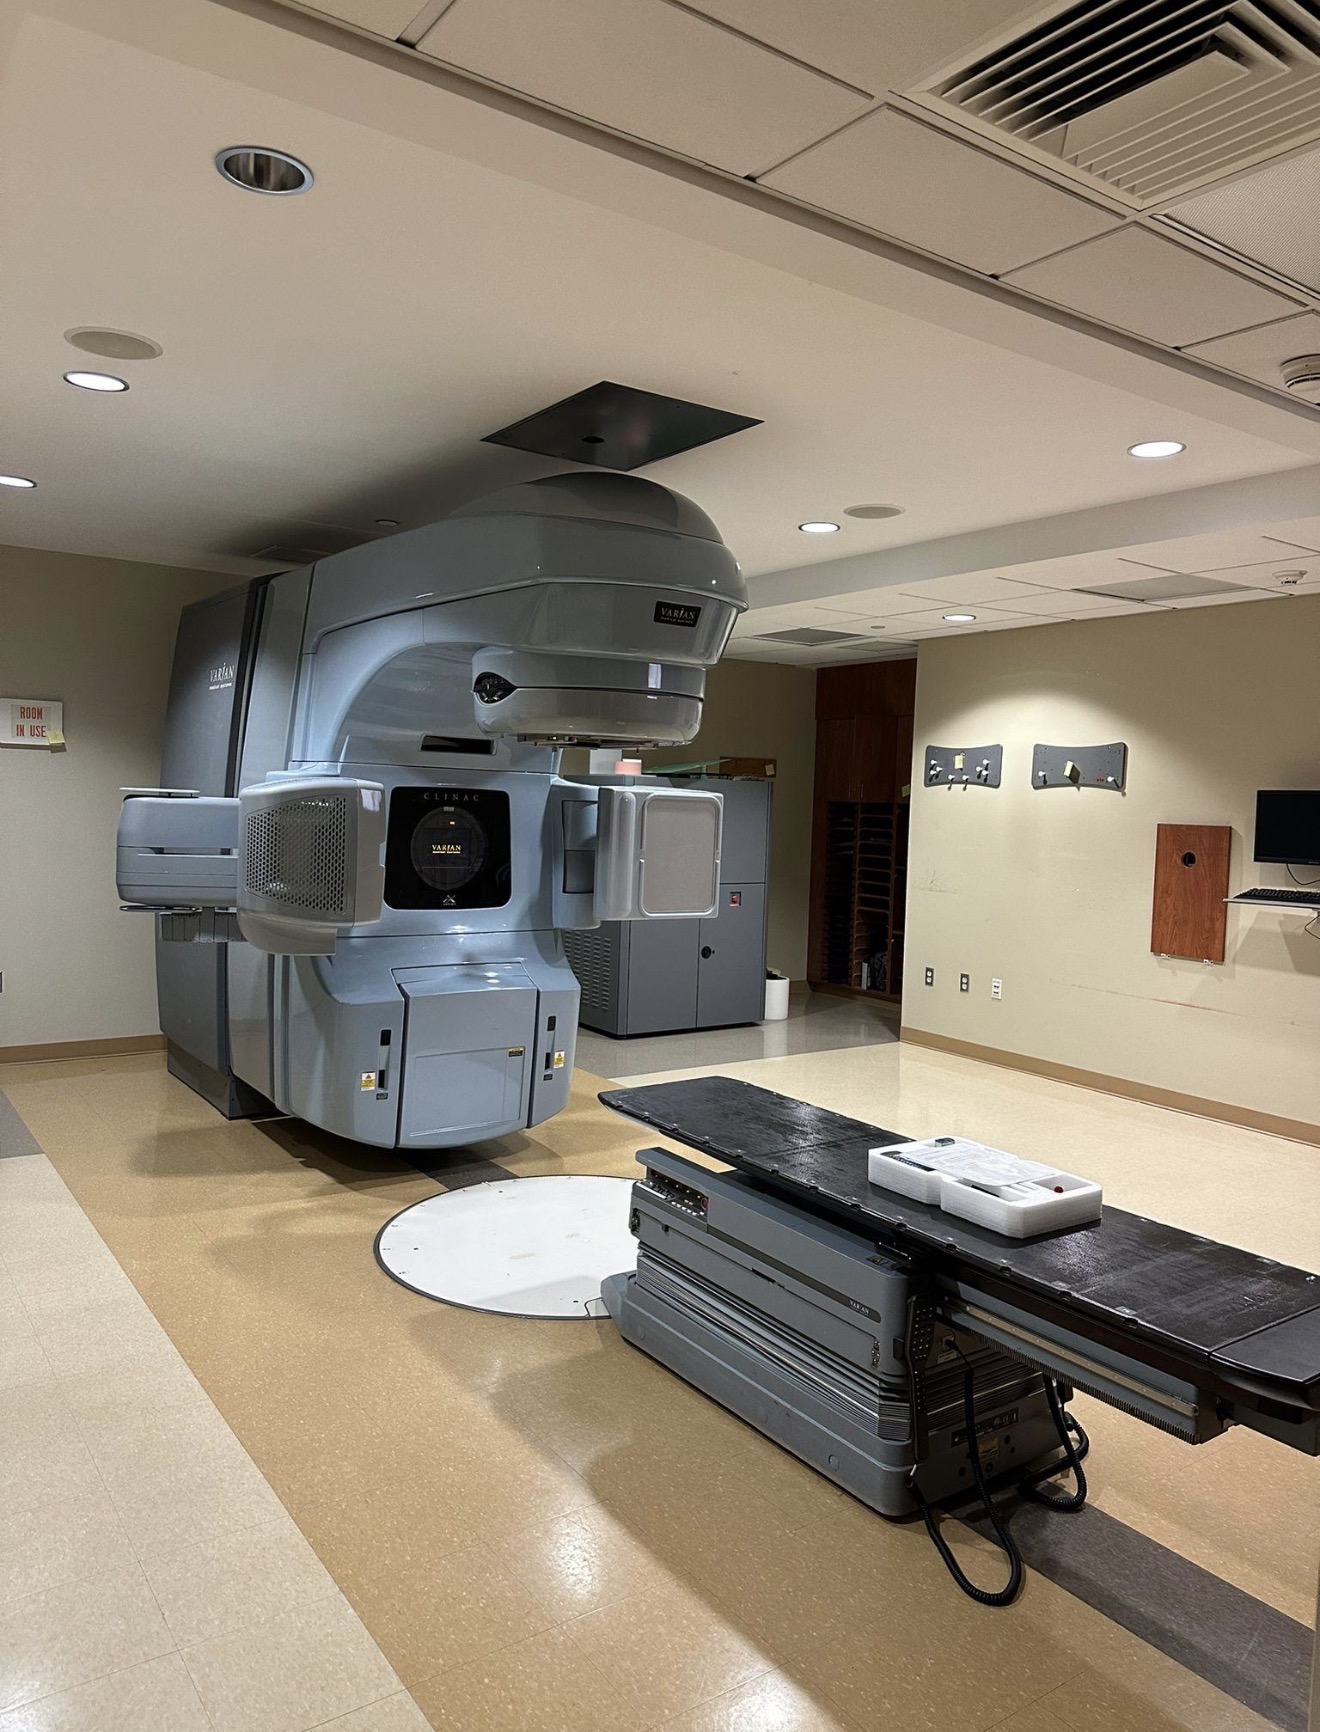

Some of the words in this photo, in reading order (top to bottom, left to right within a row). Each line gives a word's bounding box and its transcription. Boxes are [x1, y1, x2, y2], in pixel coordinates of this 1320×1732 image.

[661, 607, 696, 619] VARIAN
[210, 662, 235, 682] VARIAN
[20, 706, 43, 720] ROOM
[16, 724, 25, 737] IN
[30, 725, 47, 738] USE
[423, 792, 480, 802] CLINAC
